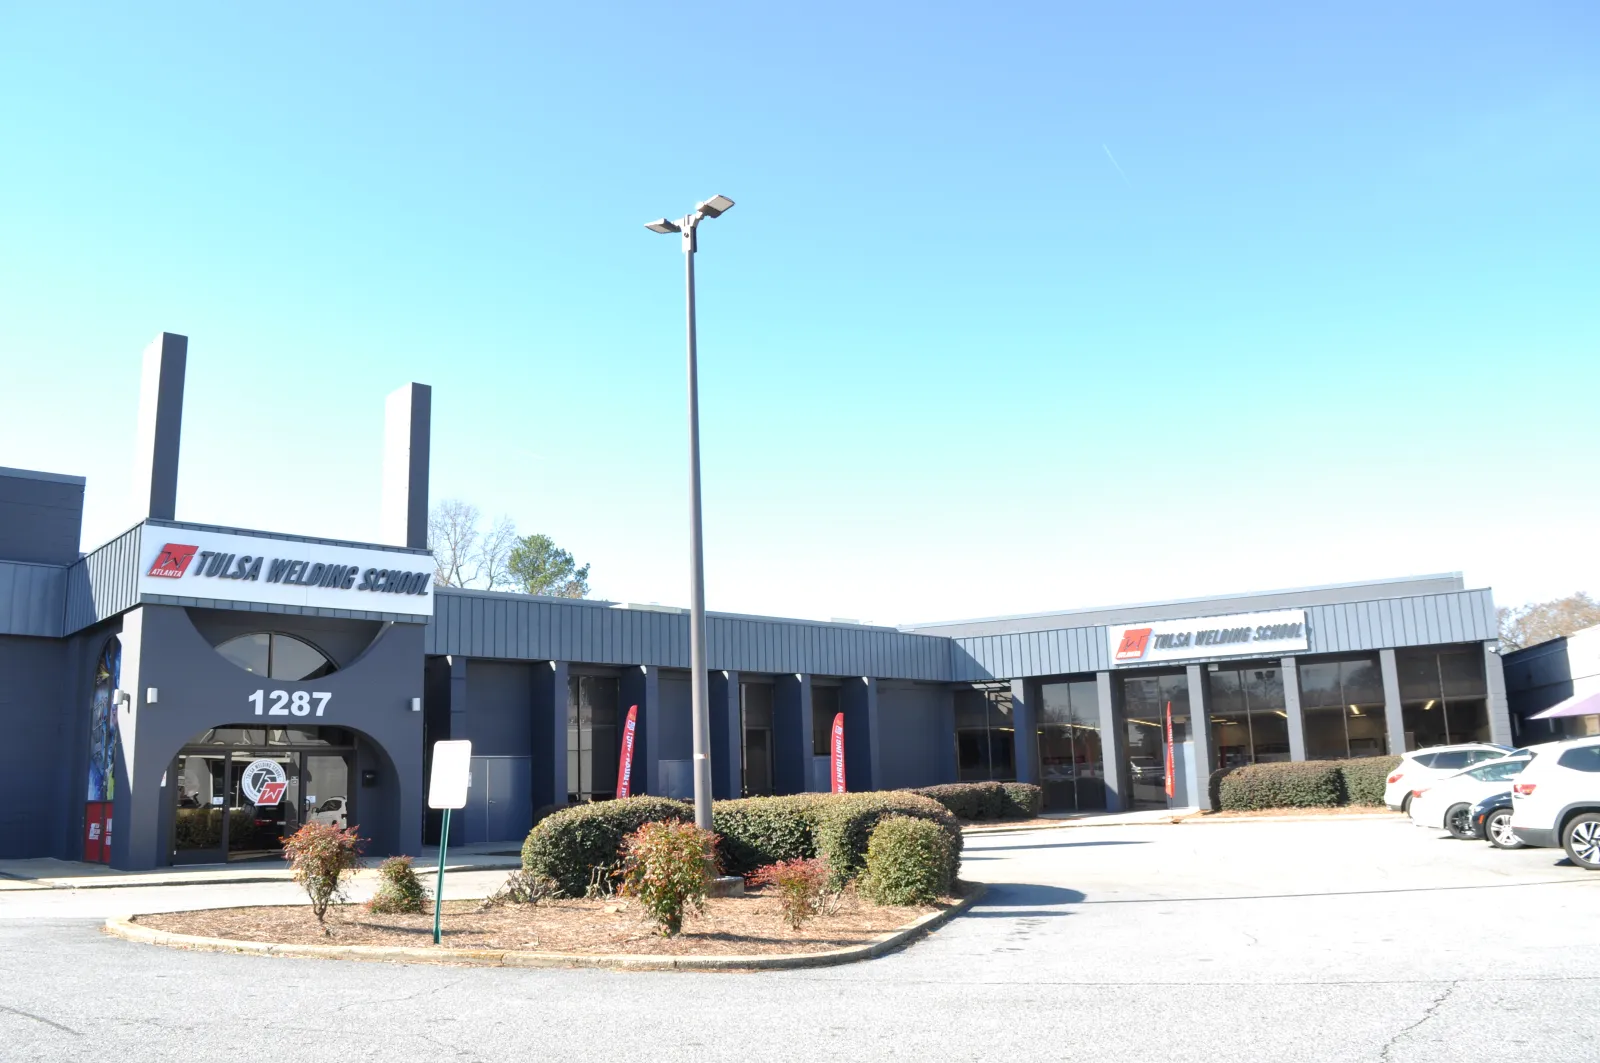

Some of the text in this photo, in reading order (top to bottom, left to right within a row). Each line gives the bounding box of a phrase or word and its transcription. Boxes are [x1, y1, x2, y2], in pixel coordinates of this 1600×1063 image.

[151, 568, 182, 577] ATLANTA
[194, 550, 432, 596] TULSA WELDING SCHOOL
[1153, 622, 1303, 650] TULSA WELDING SCHOOL
[248, 689, 332, 717] 1287
